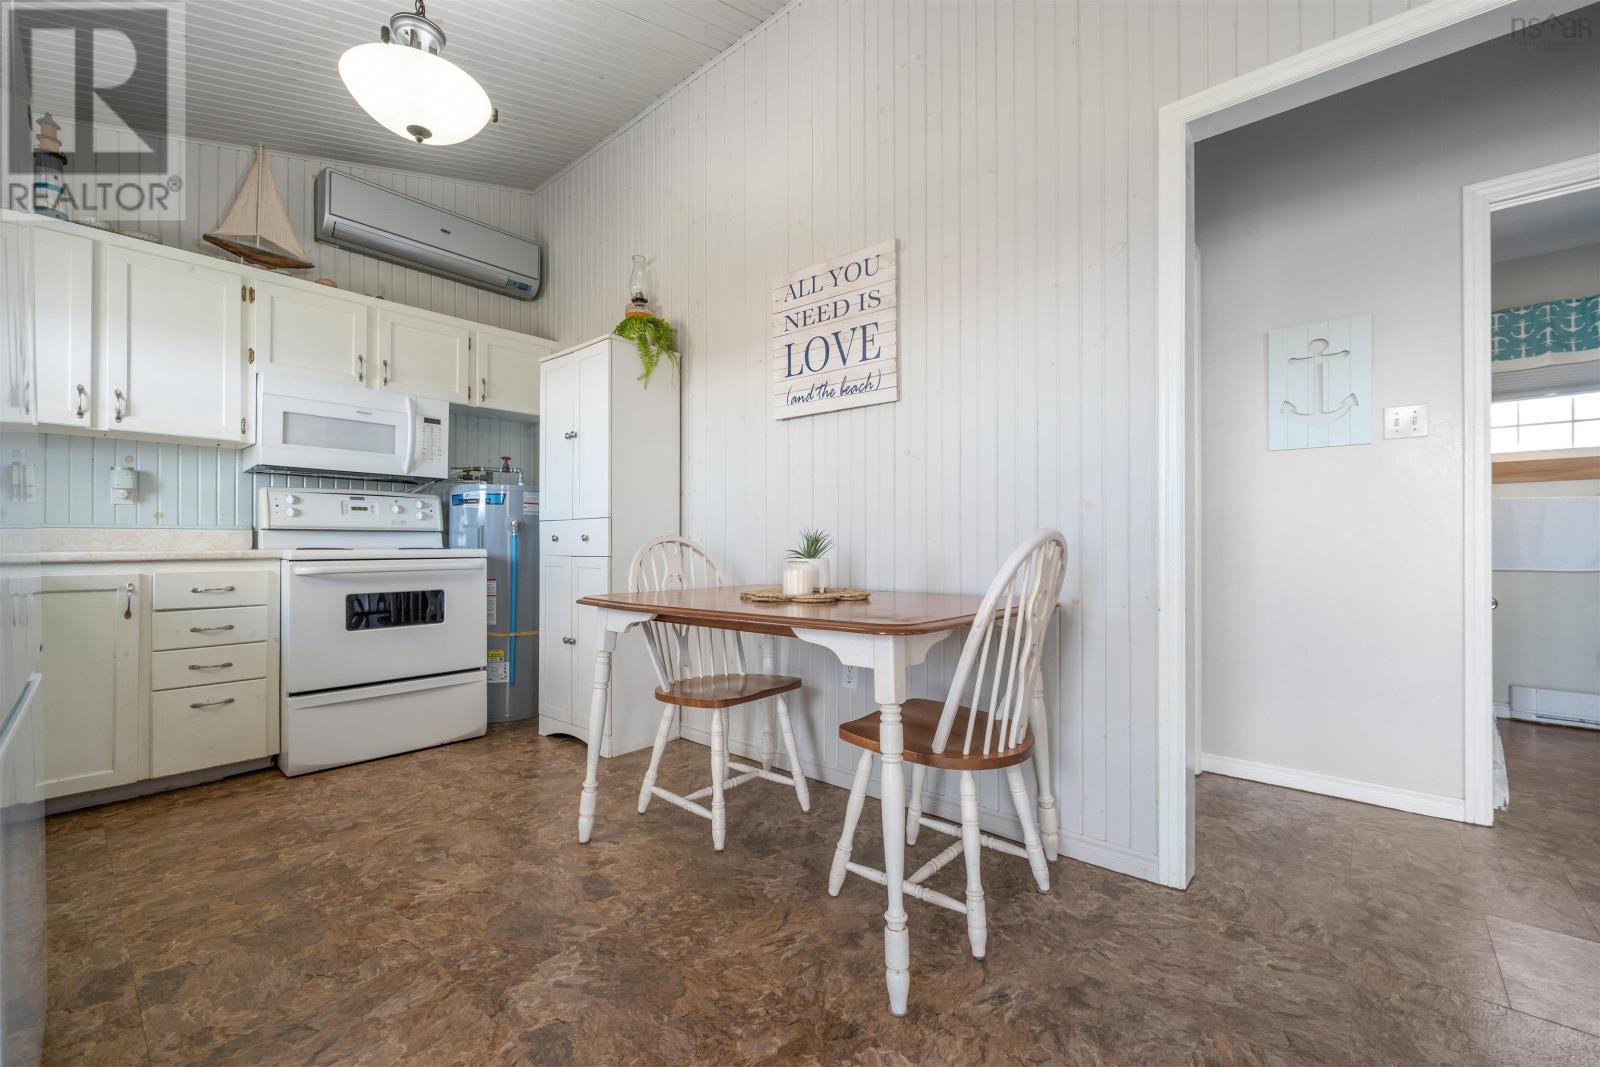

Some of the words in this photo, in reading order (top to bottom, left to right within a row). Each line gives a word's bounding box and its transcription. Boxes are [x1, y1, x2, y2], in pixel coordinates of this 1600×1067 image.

[784, 274, 824, 303] ALL
[829, 254, 881, 288] YOU
[784, 299, 850, 332] NEED
[858, 289, 881, 312] IS
[784, 321, 881, 378] LOVE
[786, 381, 815, 406] (and
[816, 380, 836, 400] the
[839, 368, 882, 397] beach)
